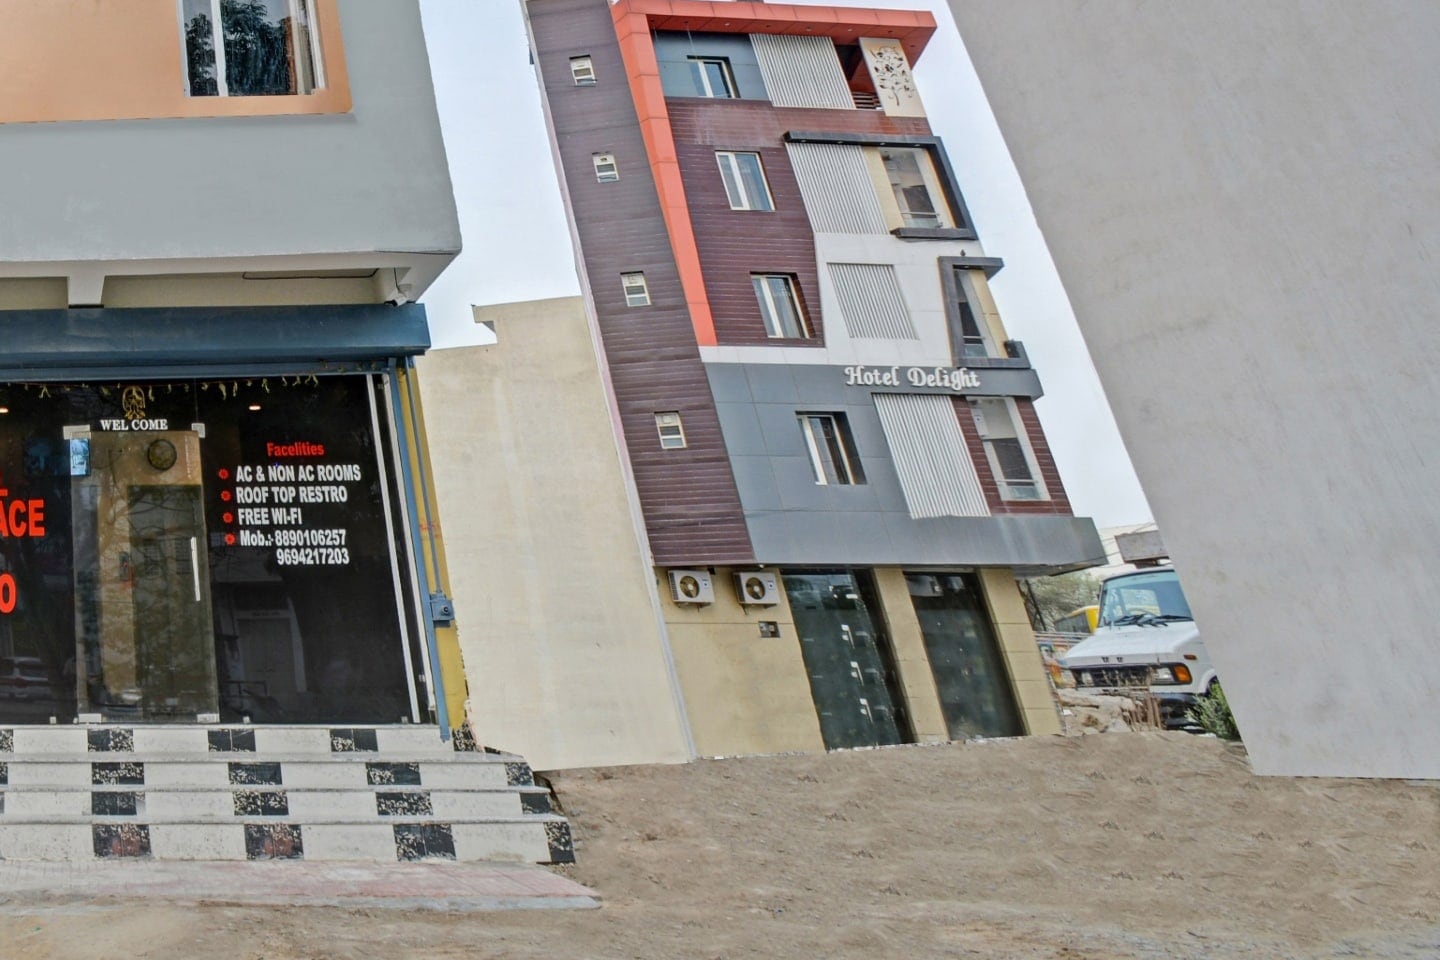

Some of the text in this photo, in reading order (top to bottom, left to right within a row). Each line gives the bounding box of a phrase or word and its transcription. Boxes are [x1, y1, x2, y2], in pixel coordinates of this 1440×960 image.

[844, 365, 981, 391] Hotel Delight
[100, 418, 168, 431] WEL COME
[266, 442, 325, 457] Facelities
[235, 464, 362, 483] AC & NON AC ROOMS
[235, 485, 348, 504] ROOF TOP RESTRO
[237, 507, 303, 525] FREE WI-FI
[274, 529, 347, 546] 8890106257
[276, 548, 350, 565] 9694217203
